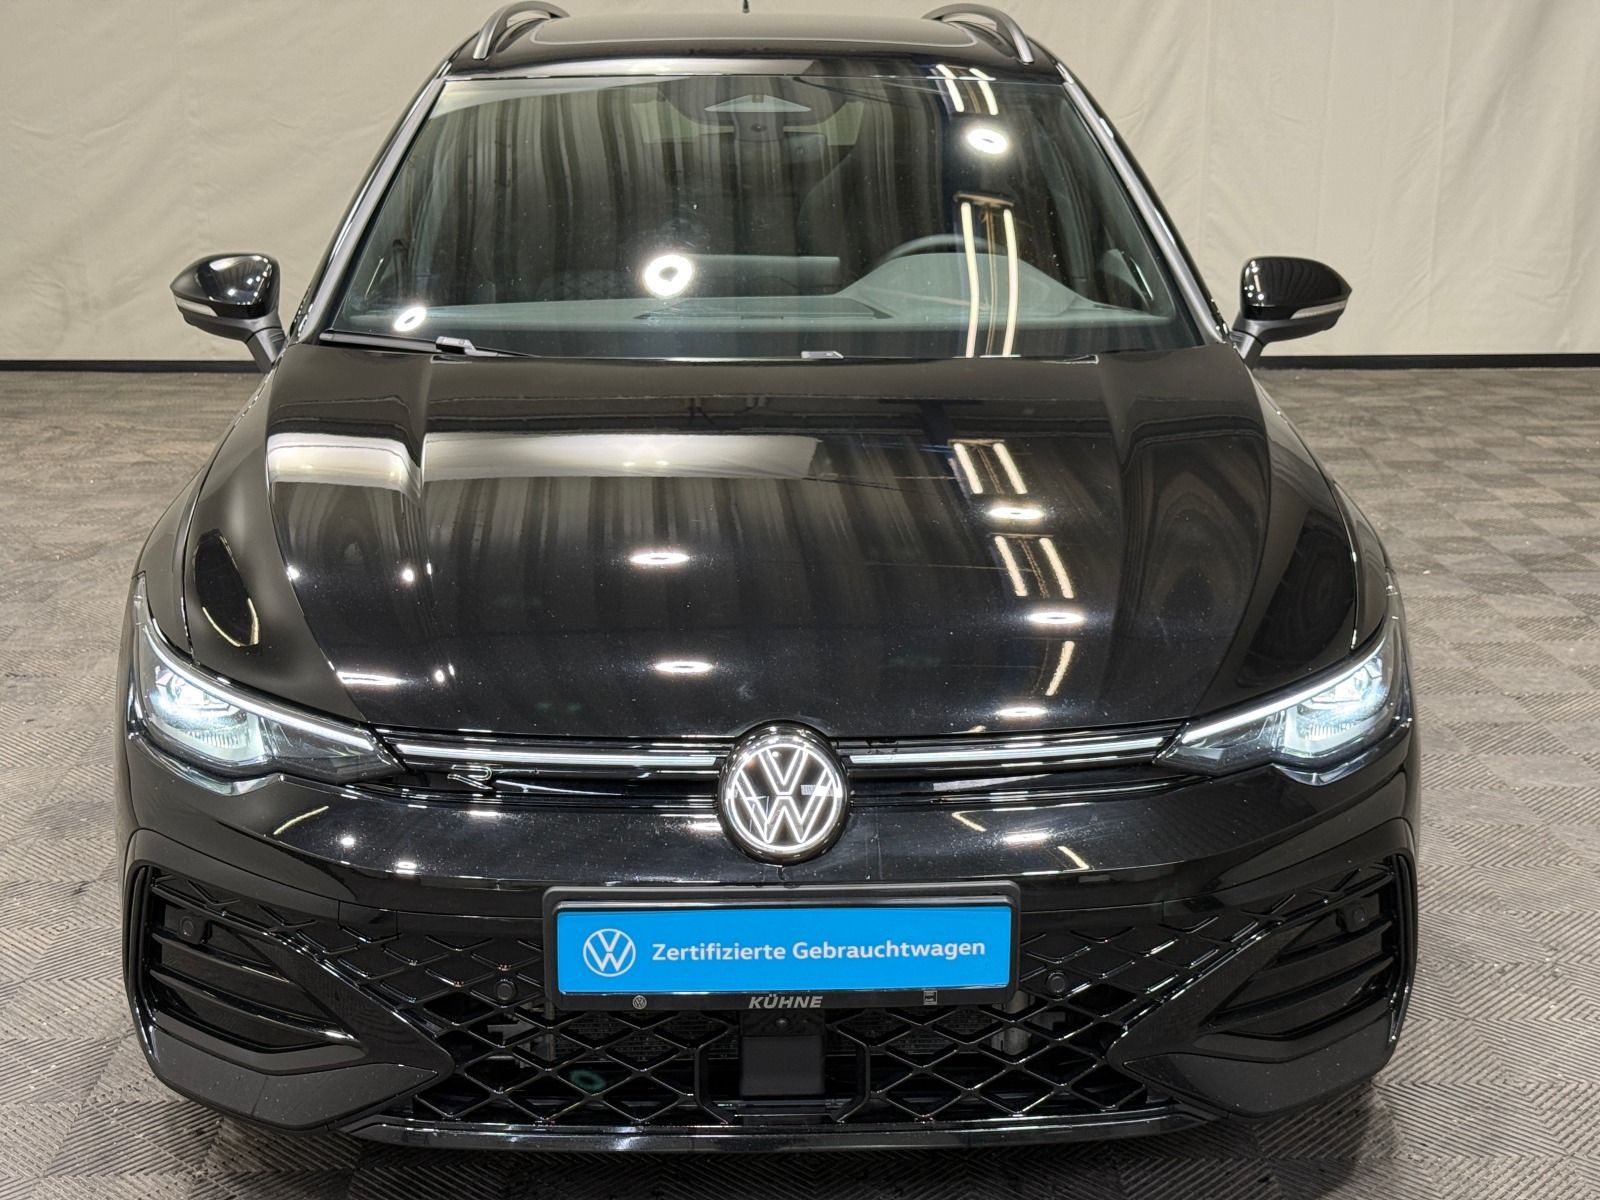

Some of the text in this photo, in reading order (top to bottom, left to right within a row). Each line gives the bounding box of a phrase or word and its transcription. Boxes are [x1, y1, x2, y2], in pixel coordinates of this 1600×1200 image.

[583, 928, 636, 977] VW
[652, 939, 985, 961] Zertifizierte Gebrauchtwagen
[748, 995, 823, 1009] KÜHNE
